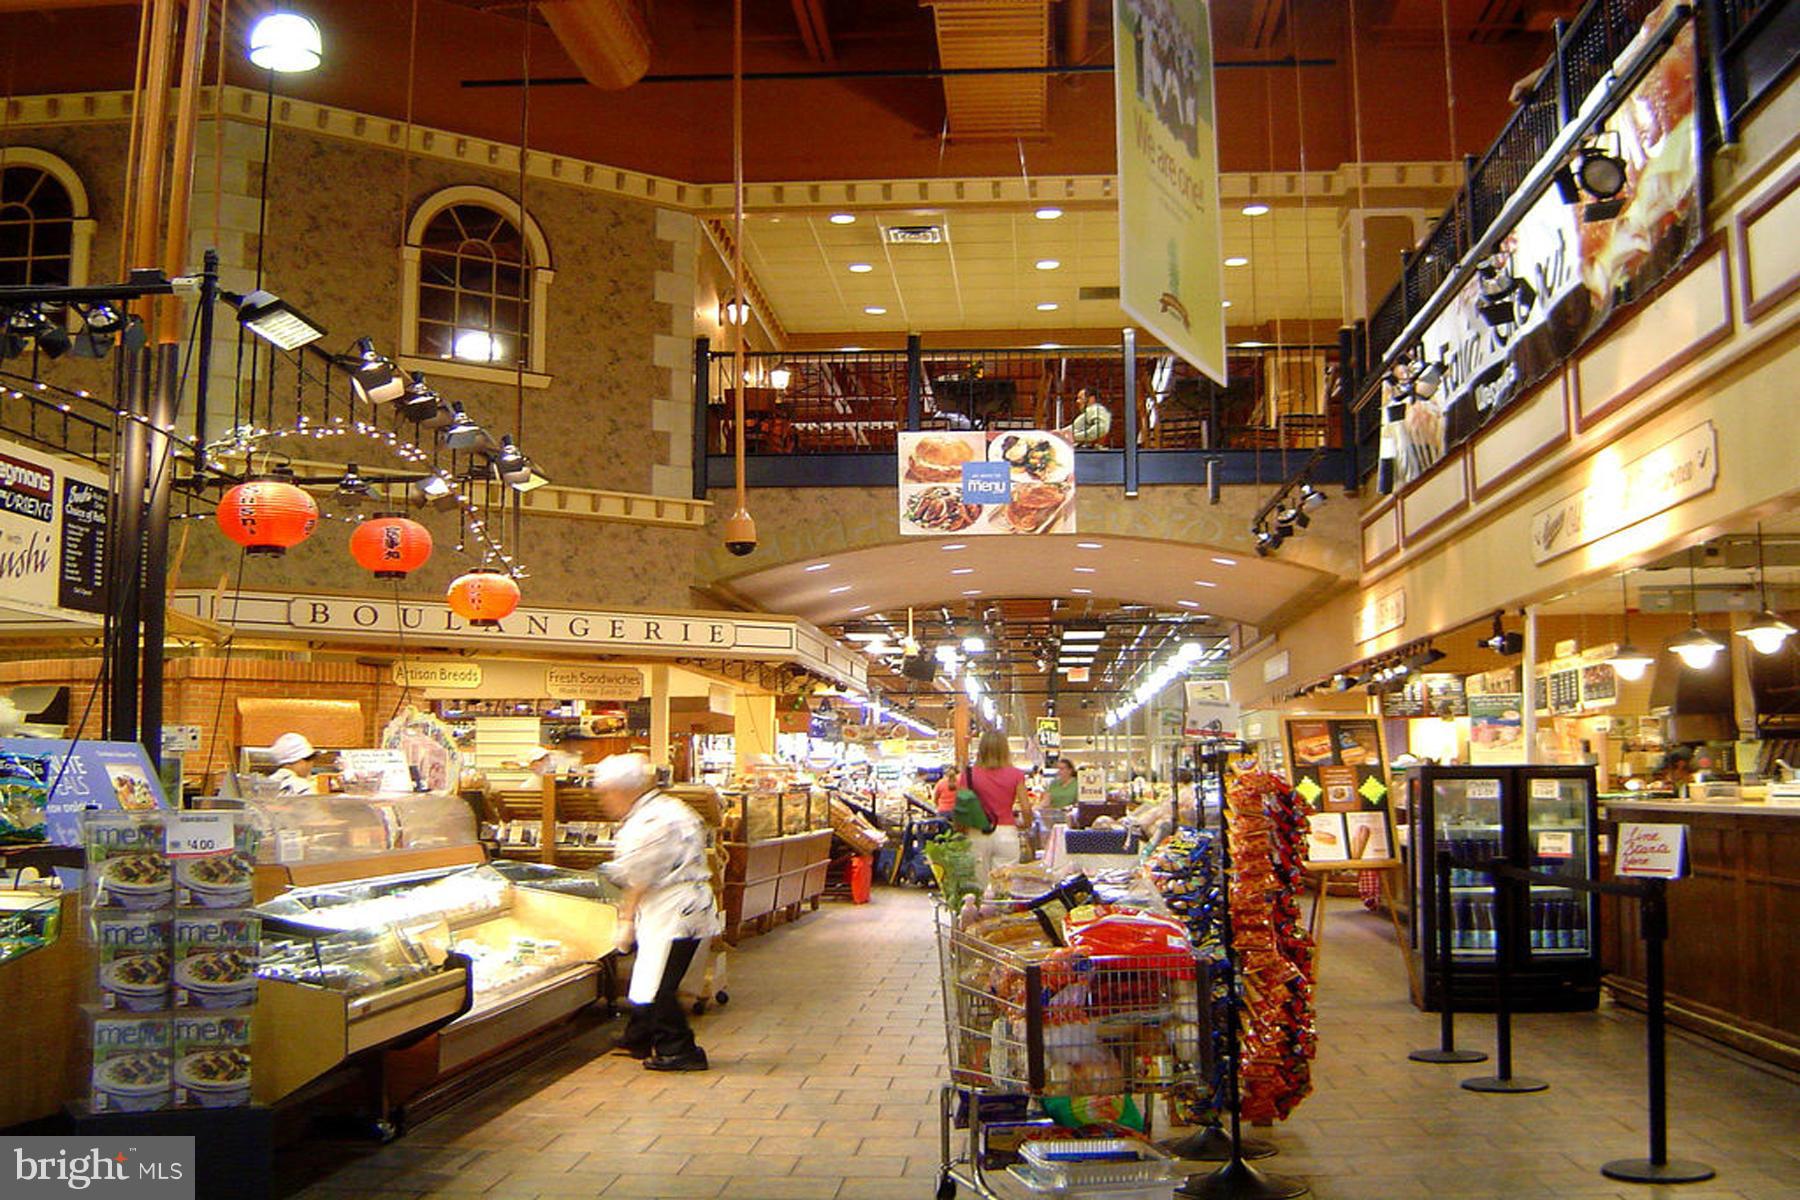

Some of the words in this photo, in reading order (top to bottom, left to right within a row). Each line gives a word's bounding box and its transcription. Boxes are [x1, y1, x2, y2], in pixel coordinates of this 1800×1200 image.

[968, 480, 1006, 494] menu
[0, 530, 51, 579] ushi
[309, 602, 725, 645] BOULNGERIE
[396, 666, 437, 682] Artisan
[439, 667, 479, 684] Breads
[549, 671, 578, 684] Fresh
[580, 671, 641, 686] Sandwiches
